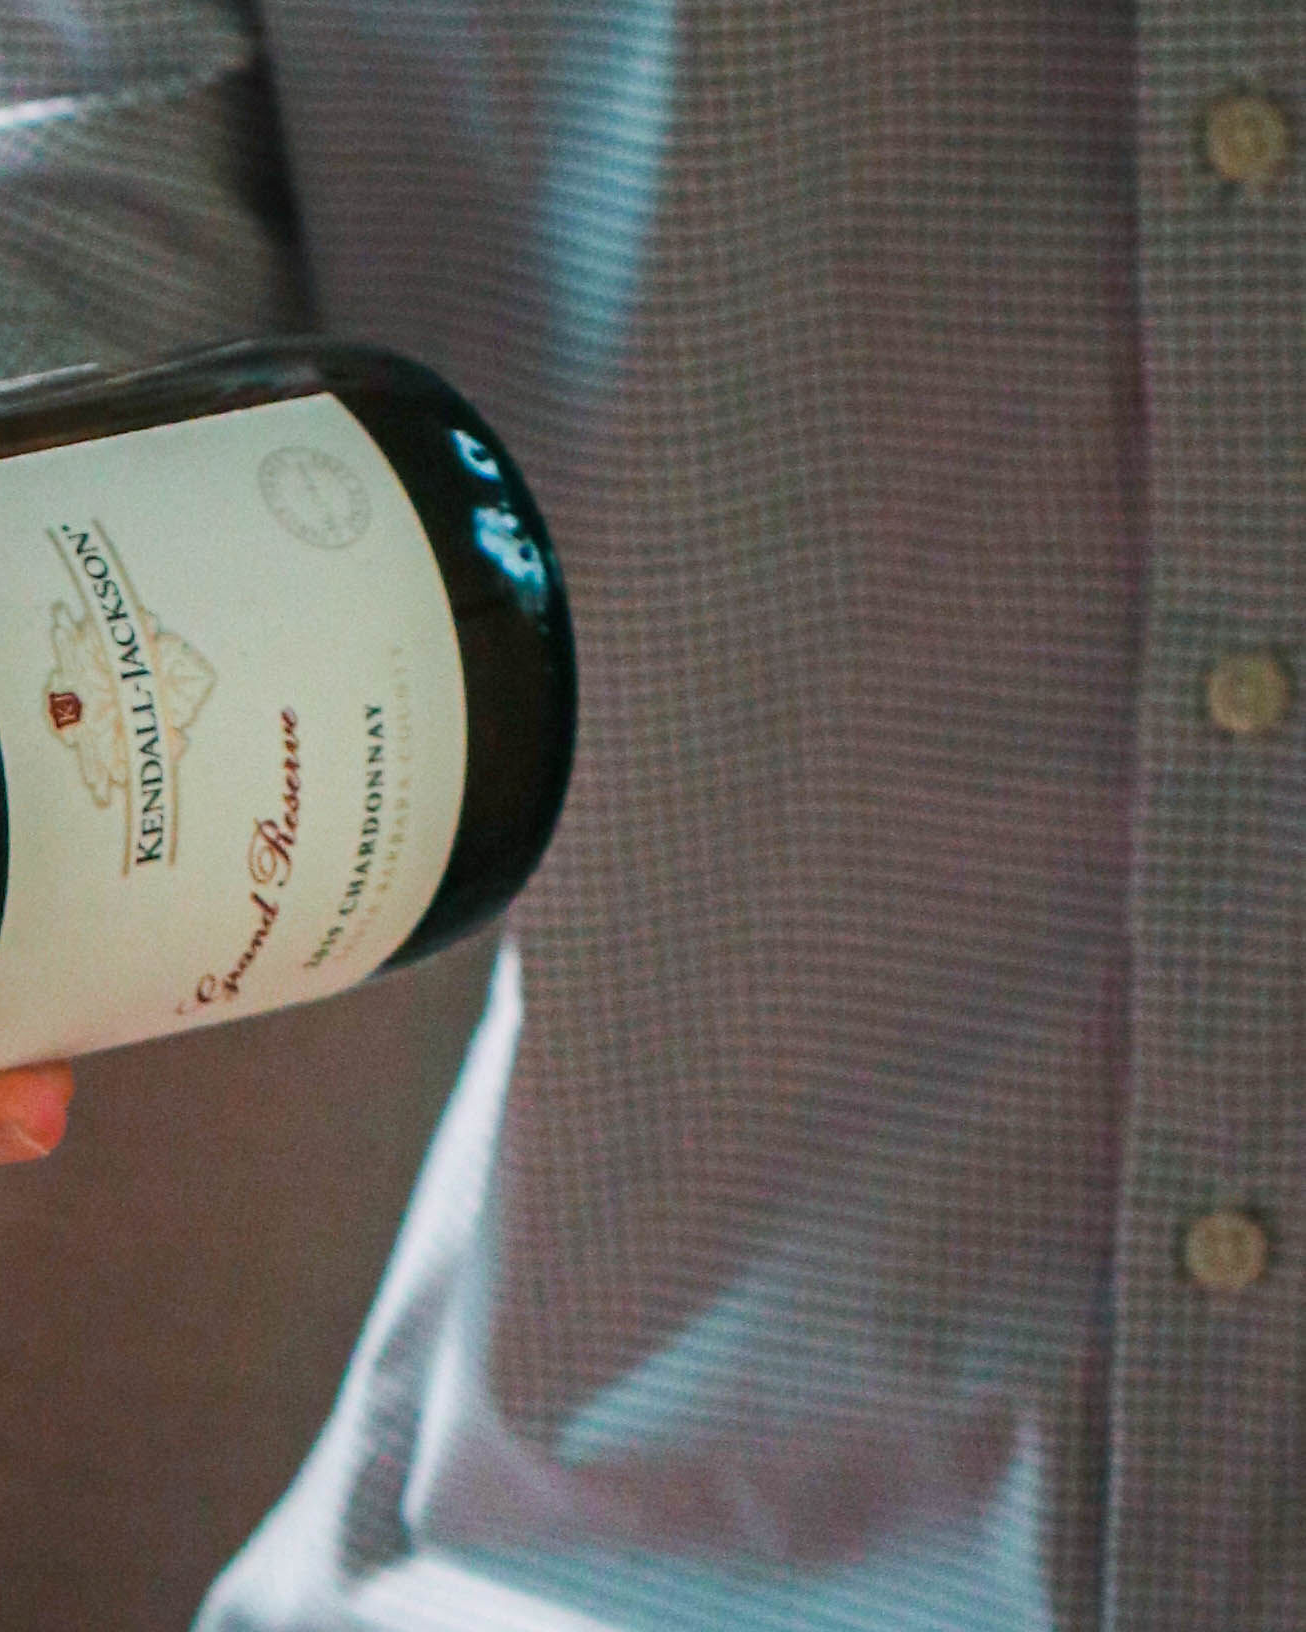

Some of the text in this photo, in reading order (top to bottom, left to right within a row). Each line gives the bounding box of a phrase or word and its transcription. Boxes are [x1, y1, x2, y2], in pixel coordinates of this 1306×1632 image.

[66, 530, 164, 865] KENDALL-JACKSON
[338, 704, 384, 916] CHARDONNAY
[176, 707, 300, 1013] Grand Reserve
